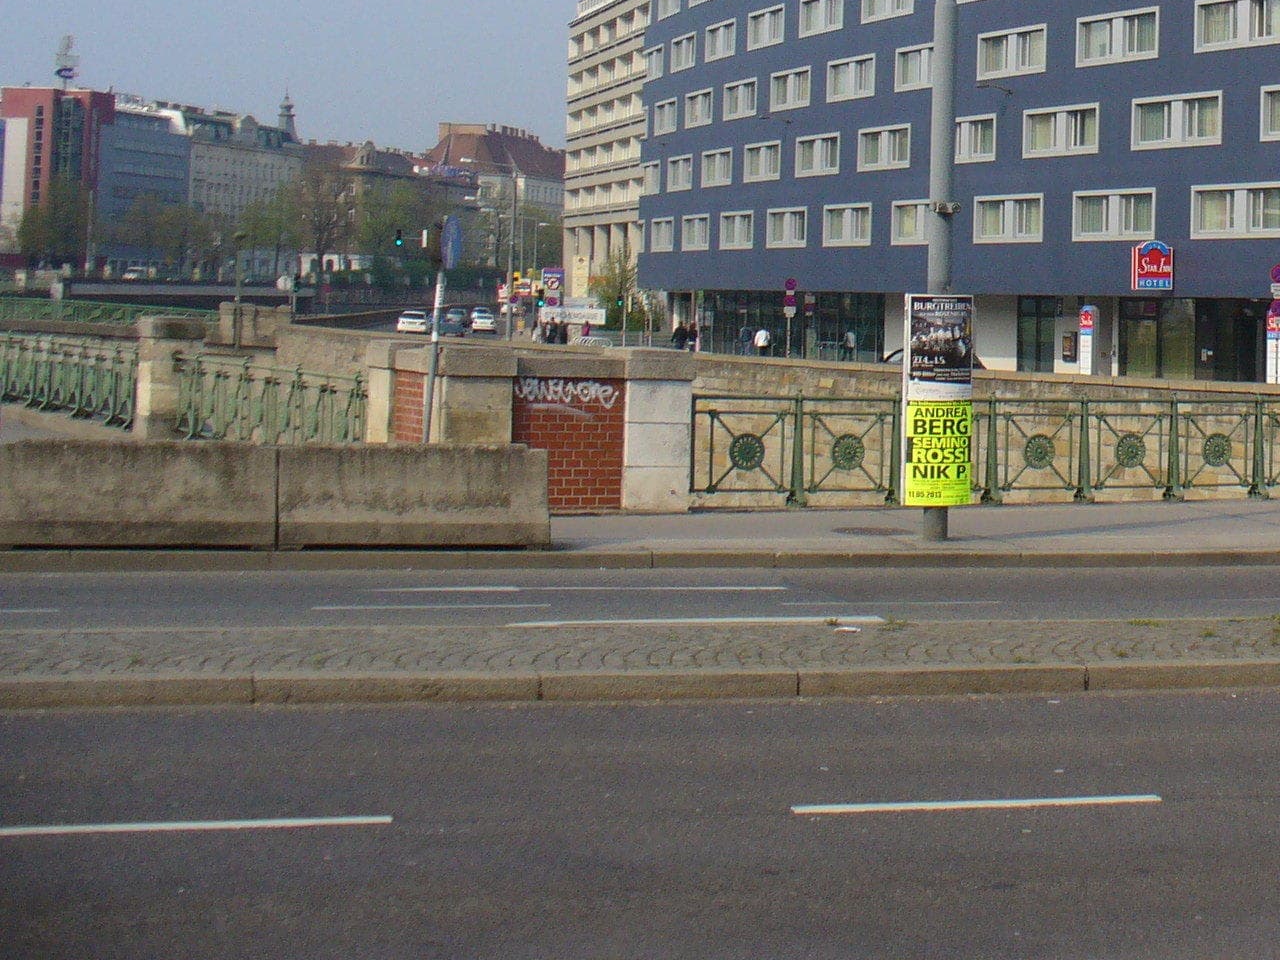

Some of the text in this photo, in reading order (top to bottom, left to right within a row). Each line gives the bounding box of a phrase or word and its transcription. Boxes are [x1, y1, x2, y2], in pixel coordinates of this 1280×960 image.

[1138, 257, 1172, 274] STAR INN
[914, 407, 967, 418] ANDREA
[913, 419, 968, 435] BERG
[912, 437, 968, 449] SEMINO
[912, 449, 968, 463] ROSSI
[912, 465, 968, 479] NIK P.
